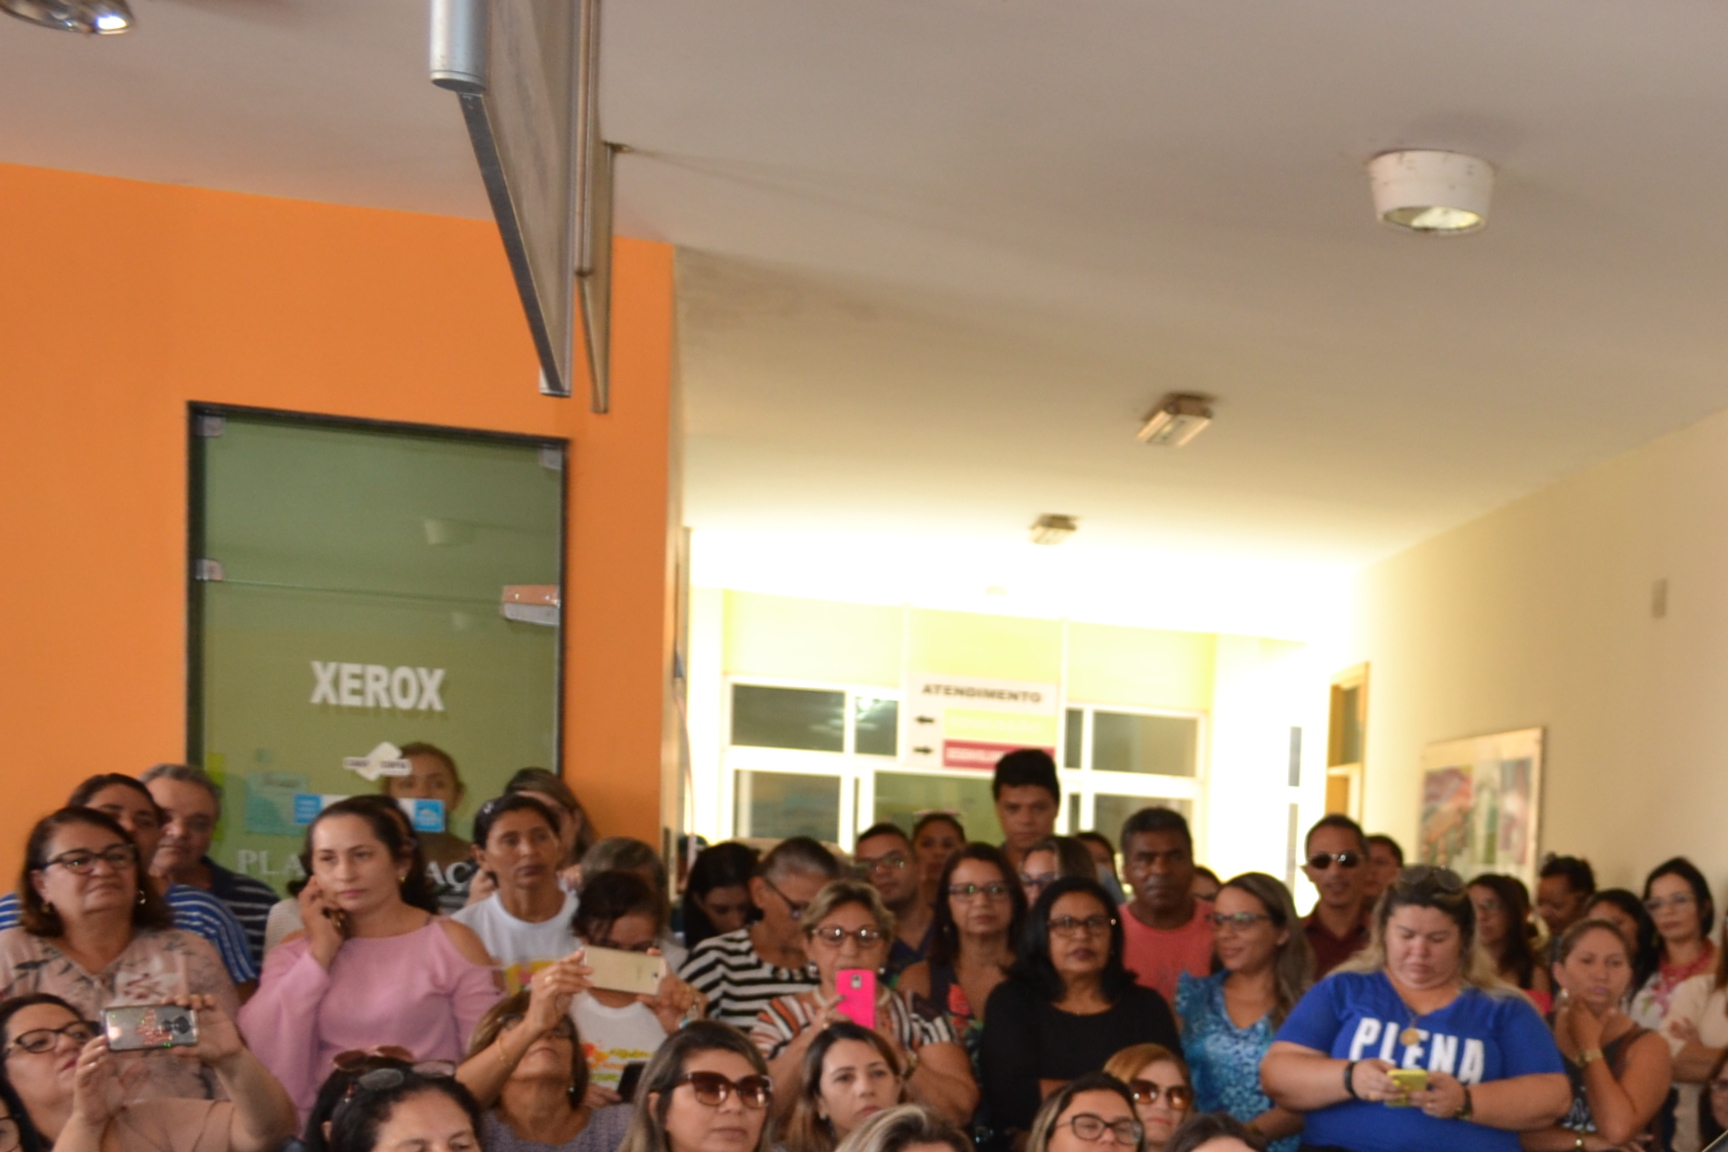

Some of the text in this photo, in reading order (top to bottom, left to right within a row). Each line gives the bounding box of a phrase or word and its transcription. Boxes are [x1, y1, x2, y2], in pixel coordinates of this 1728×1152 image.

[310, 661, 446, 711] XEROX
[922, 684, 1042, 703] ATENDIMENTO
[1349, 1017, 1484, 1085] PLENA
